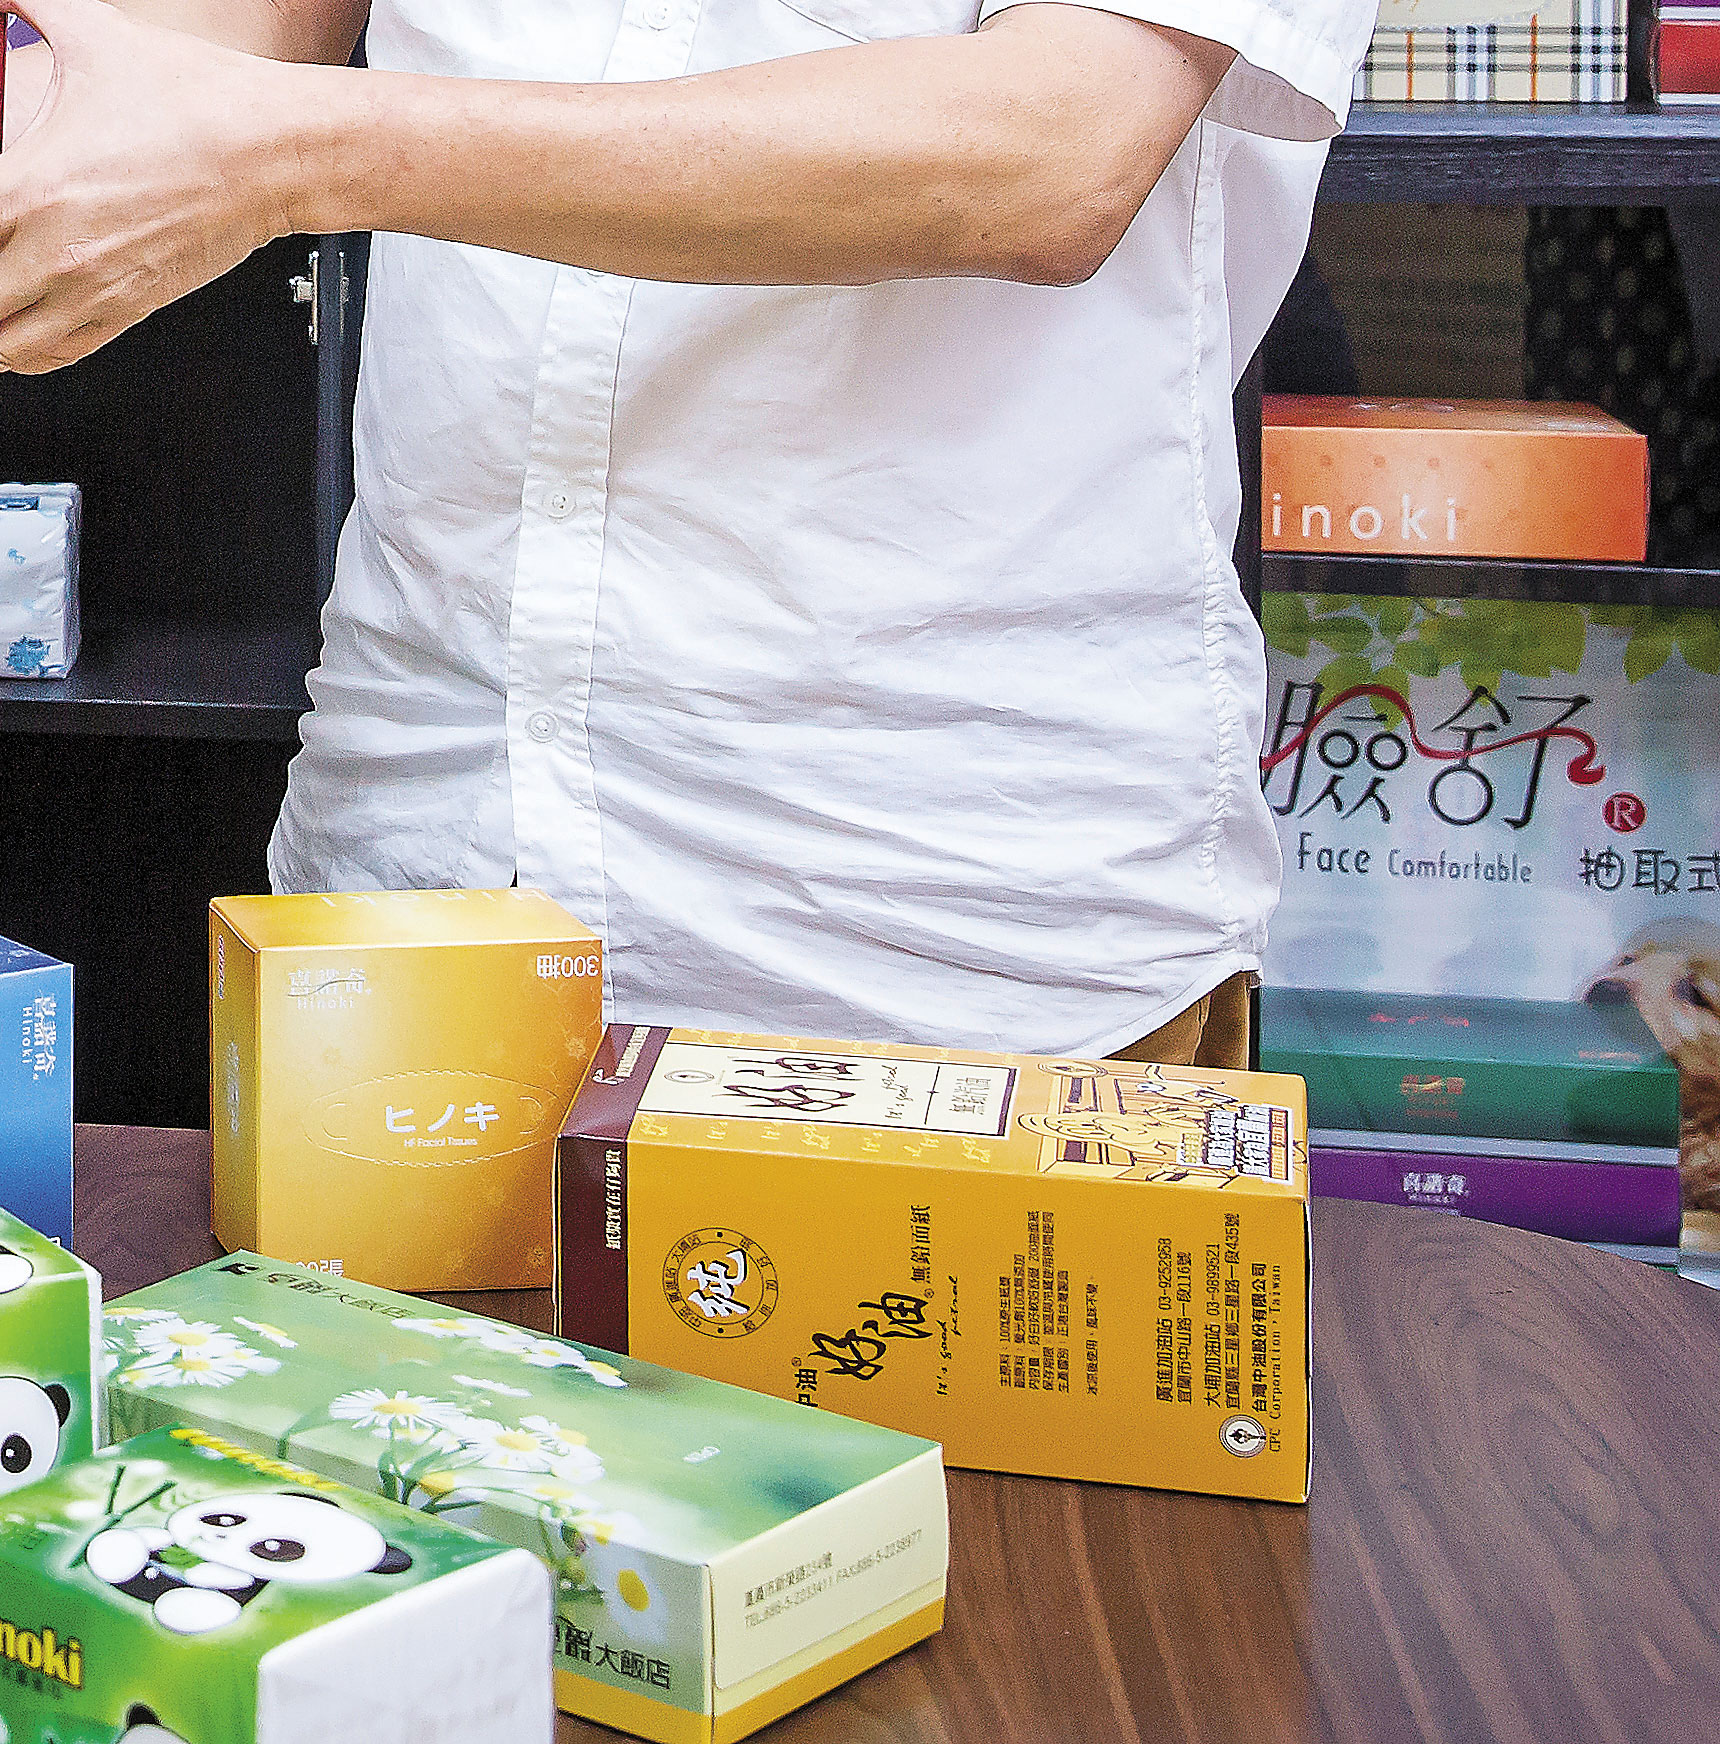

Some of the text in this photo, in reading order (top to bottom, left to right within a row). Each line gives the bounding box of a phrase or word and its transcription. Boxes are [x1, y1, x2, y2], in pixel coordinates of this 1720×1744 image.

[1270, 492, 1458, 543] inoki
[1299, 832, 1532, 884] Face Comfortable
[22, 1007, 34, 1064] Hinoki
[386, 1102, 500, 1133] ヒノキ
[910, 1204, 931, 1284] 無鉛面紙
[687, 1249, 751, 1318] 純
[1268, 1264, 1281, 1315] Taiwan
[1156, 1318, 1173, 1403] 廣進加油站
[1204, 1323, 1221, 1409] 大埔加油站
[1251, 1262, 1268, 1413] 台灣中油股份有限公司
[1269, 1427, 1281, 1453] CPC
